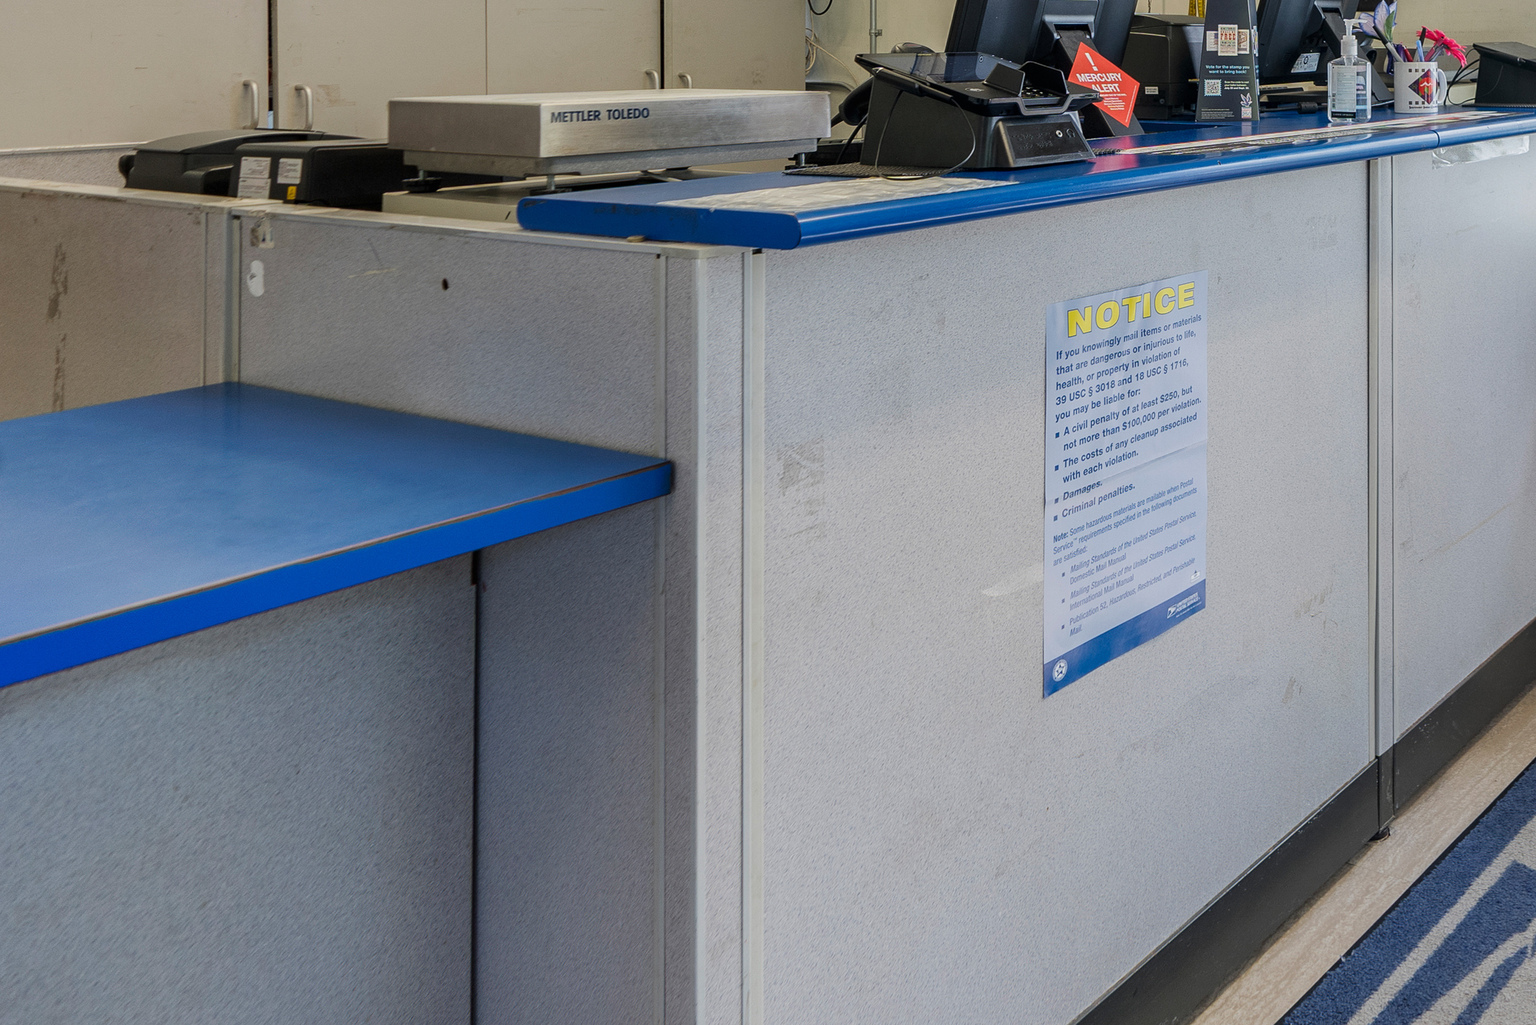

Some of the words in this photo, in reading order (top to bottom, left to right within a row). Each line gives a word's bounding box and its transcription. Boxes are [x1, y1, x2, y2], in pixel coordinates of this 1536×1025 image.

[1076, 72, 1122, 83] MERCURY
[1092, 83, 1121, 93] ALERT
[550, 110, 601, 123] METTLER
[606, 107, 650, 120] TOLEDO
[1067, 281, 1195, 338] NOTICE
[1056, 350, 1064, 360] If
[1065, 348, 1080, 360] you
[1082, 336, 1121, 353] knowingly
[1123, 330, 1138, 342] mail
[1140, 326, 1162, 338] items
[1164, 324, 1171, 332] or
[1172, 314, 1202, 329] materials
[1056, 363, 1074, 375] that
[1076, 360, 1088, 370] are
[1090, 348, 1131, 366] dangerous
[1132, 345, 1142, 354] or
[1144, 336, 1174, 351] injurious
[1176, 334, 1183, 342] to
[1184, 330, 1196, 340] life,
[1056, 376, 1084, 390] health,
[1086, 373, 1095, 382] or
[1096, 362, 1130, 380] property
[1132, 360, 1140, 368] in
[1142, 351, 1172, 366] violation
[1174, 347, 1181, 356] of
[1056, 395, 1067, 406] 39
[1069, 388, 1086, 402] USC
[1088, 386, 1094, 397] §
[1095, 380, 1116, 393] 3018
[1118, 375, 1132, 386] and
[1135, 371, 1144, 382] 18
[1146, 366, 1162, 378] USC
[1164, 364, 1168, 374] §
[1170, 358, 1189, 370] 1716,
[1055, 410, 1070, 423] you
[1072, 404, 1089, 416] may
[1091, 400, 1101, 410] be
[1104, 392, 1125, 406] liable
[1128, 388, 1141, 399] for:
[1064, 426, 1070, 436] A
[1072, 420, 1088, 432] civil
[1090, 411, 1120, 428] penalty
[1122, 406, 1130, 416] of
[1132, 404, 1139, 414] at
[1141, 397, 1158, 410] least
[1160, 390, 1180, 403] $250,
[1182, 386, 1193, 396] but
[1064, 439, 1077, 451] not
[1080, 432, 1100, 446] more
[1102, 426, 1120, 438] than
[1122, 412, 1156, 430] $100,000
[1158, 408, 1170, 419] per
[1171, 397, 1202, 413] violation.
[1063, 456, 1078, 468] The
[1081, 448, 1104, 462] costs
[1105, 443, 1113, 453] of
[1115, 438, 1128, 450] any
[1130, 428, 1158, 444] cleanup
[1160, 412, 1198, 433] associated
[1063, 470, 1080, 483] with
[1083, 462, 1103, 476] each
[1105, 450, 1139, 468] violation.
[1053, 532, 1068, 543] Note:
[1070, 525, 1085, 536] Some
[1086, 513, 1112, 529] hazardous
[1113, 502, 1136, 517] materials
[1137, 499, 1145, 508] are
[1166, 485, 1179, 495] when
[1180, 477, 1194, 489] Postal
[1062, 497, 1096, 518] Criminal
[1098, 483, 1136, 505] penalties.
[1063, 480, 1103, 501] Damages.
